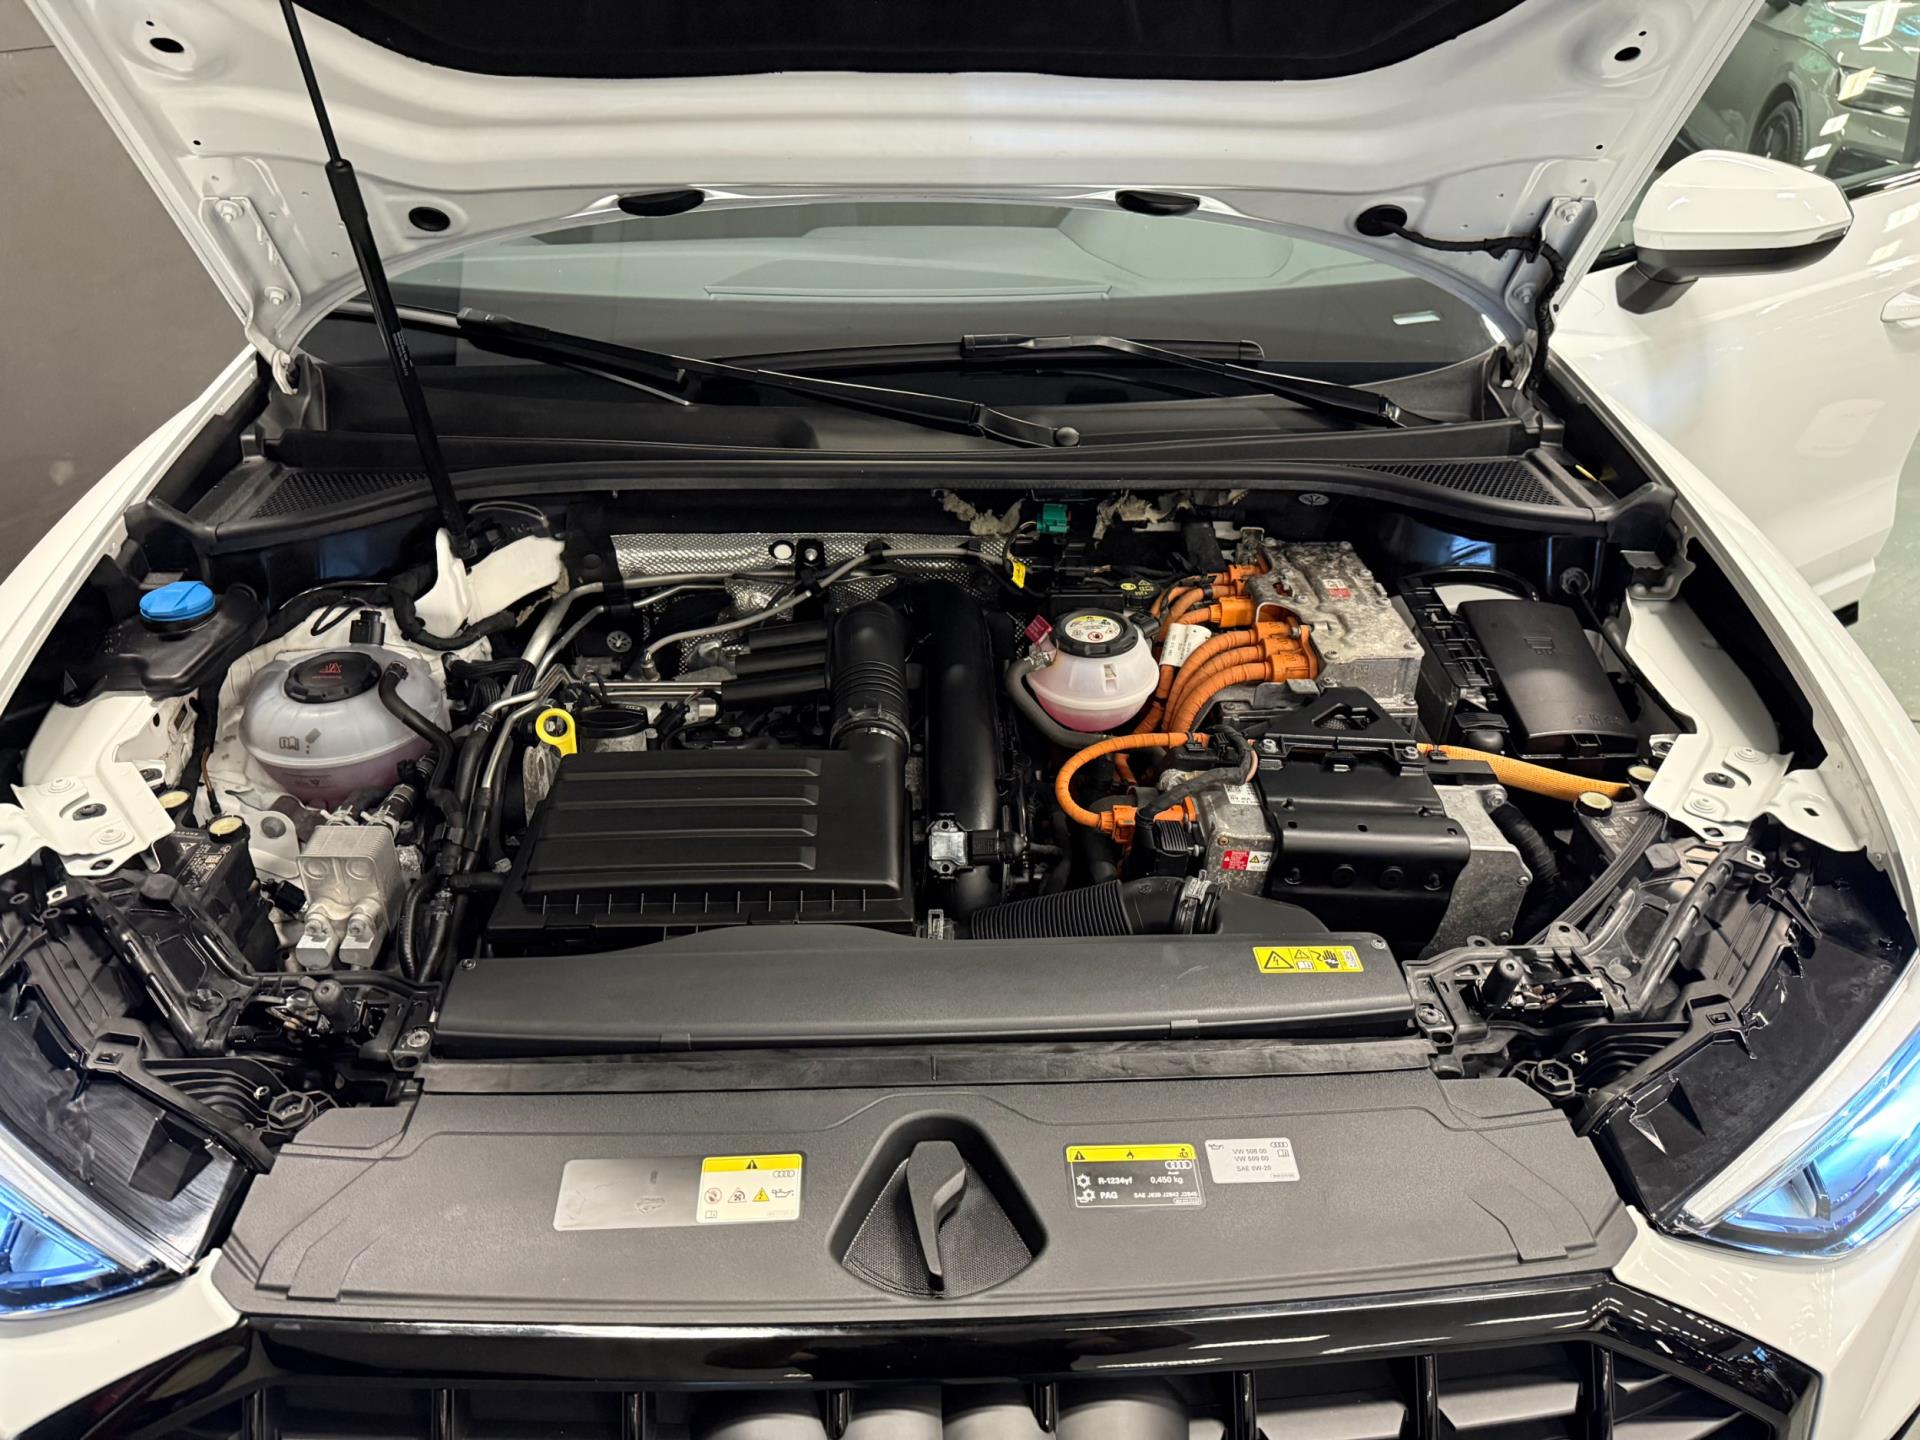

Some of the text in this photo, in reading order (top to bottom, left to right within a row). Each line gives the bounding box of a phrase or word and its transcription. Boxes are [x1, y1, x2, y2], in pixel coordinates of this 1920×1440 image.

[1098, 1175, 1184, 1185] R-1234yf 0,450 kg
[1100, 1191, 1119, 1199] PAG
